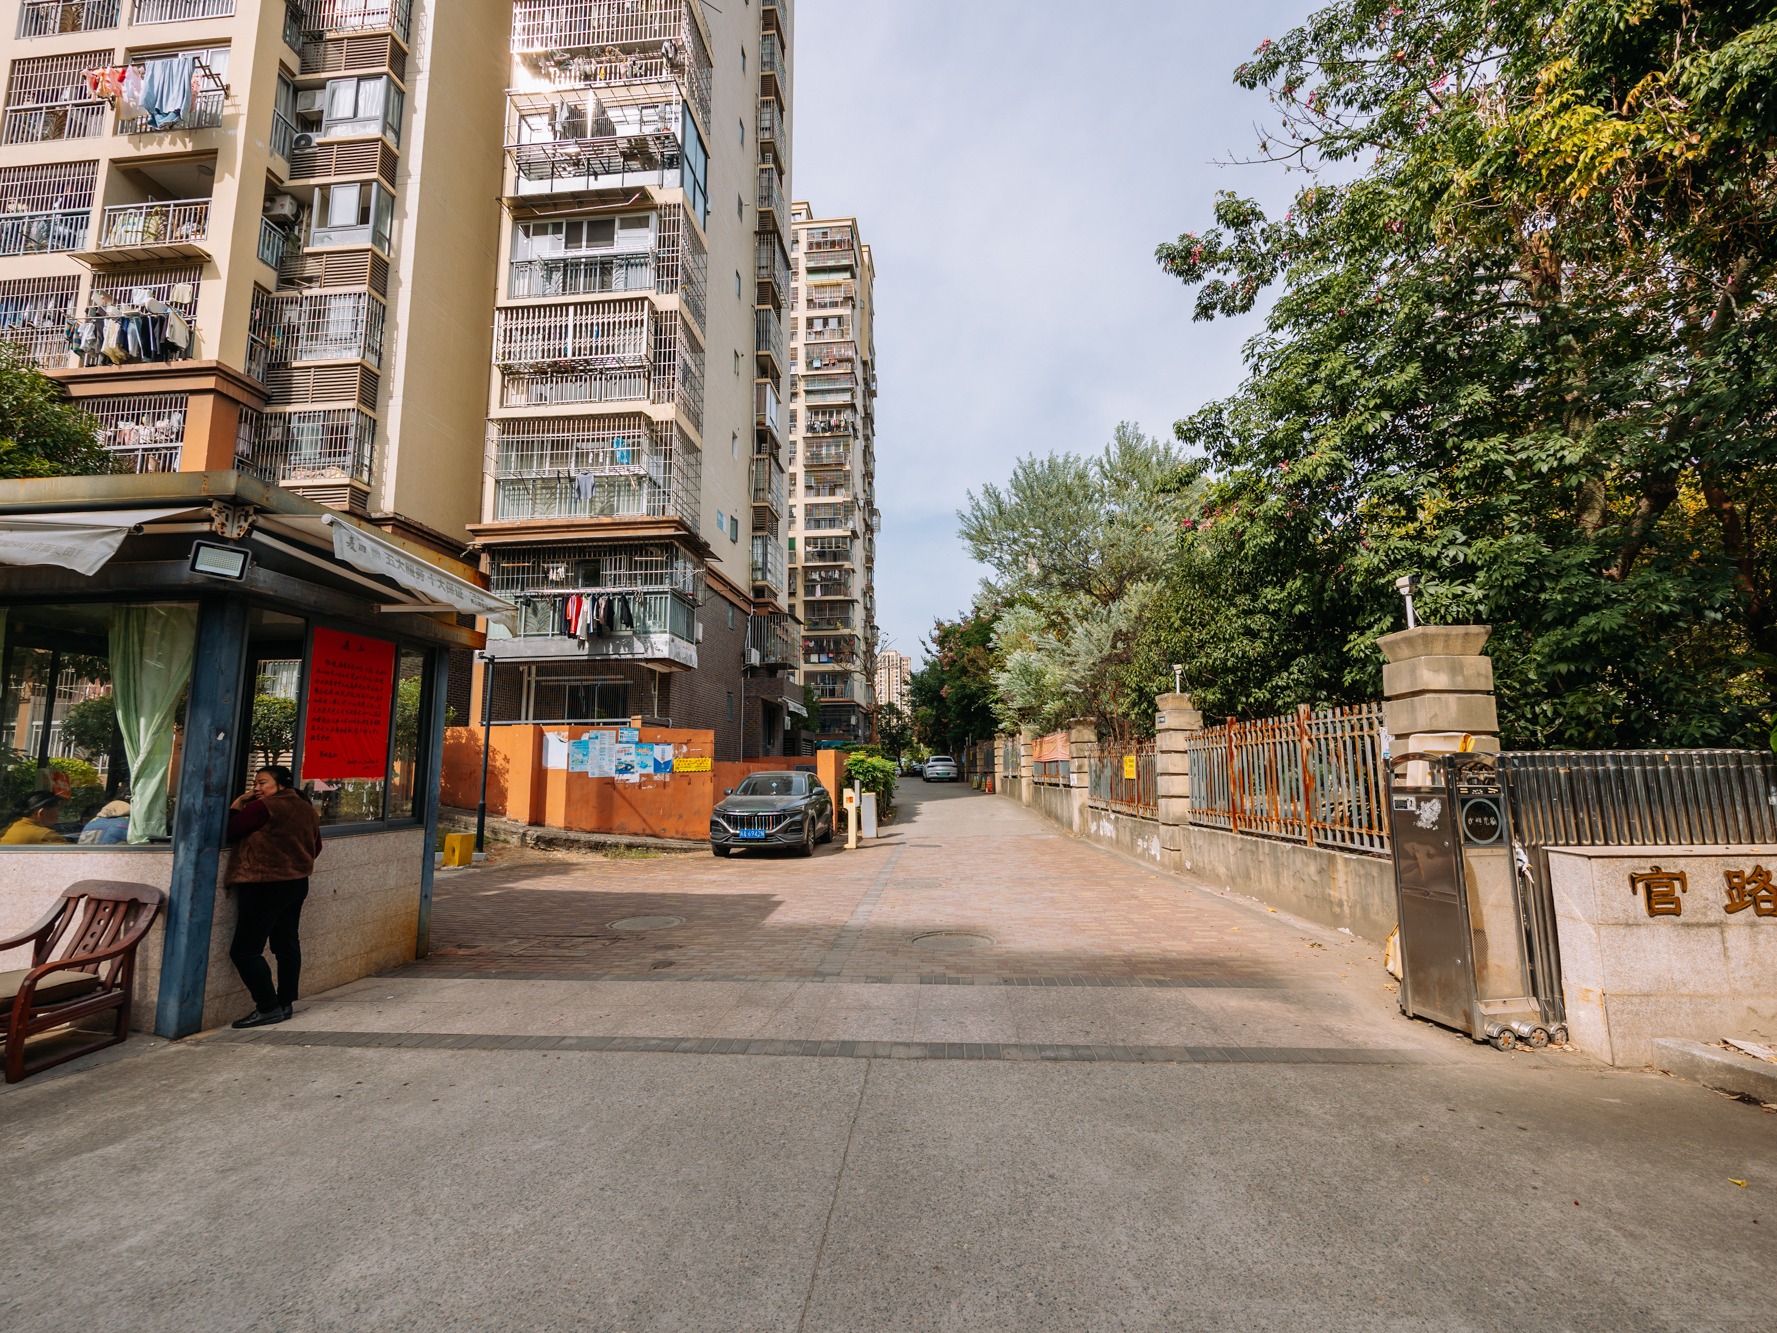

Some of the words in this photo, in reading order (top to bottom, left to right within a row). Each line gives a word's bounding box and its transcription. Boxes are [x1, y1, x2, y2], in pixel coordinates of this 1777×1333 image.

[346, 536, 367, 554] 麦田
[384, 551, 425, 582] 五大服务
[1628, 864, 1777, 917] 官路
